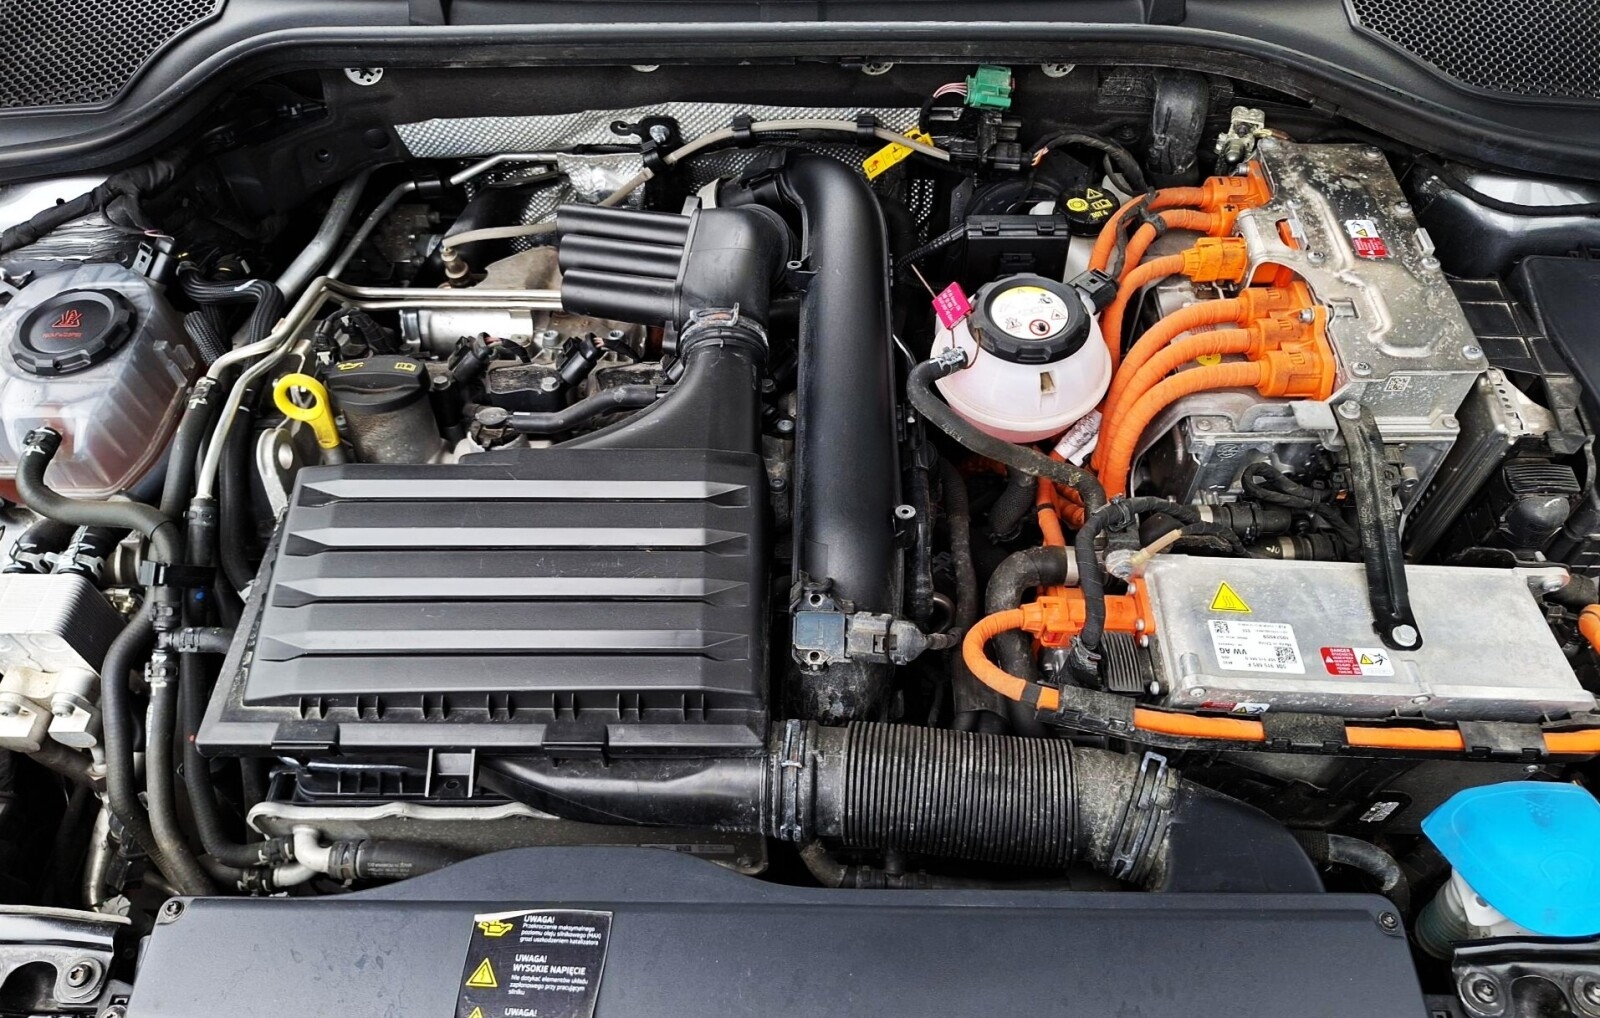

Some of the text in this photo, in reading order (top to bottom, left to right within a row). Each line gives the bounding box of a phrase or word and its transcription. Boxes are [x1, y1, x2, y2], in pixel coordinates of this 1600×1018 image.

[523, 915, 556, 923] UWAGA!
[522, 922, 596, 933] Przekroczenie maksymalnego
[520, 929, 544, 937] poziomu
[556, 930, 587, 938] silnikowego
[586, 932, 602, 940] (MAX)
[569, 937, 599, 946] katalizatora
[514, 954, 548, 963] UWAGA!
[512, 963, 587, 976] WYSOKIE NAPIĘCIE
[504, 1007, 538, 1017] UWAGA!
